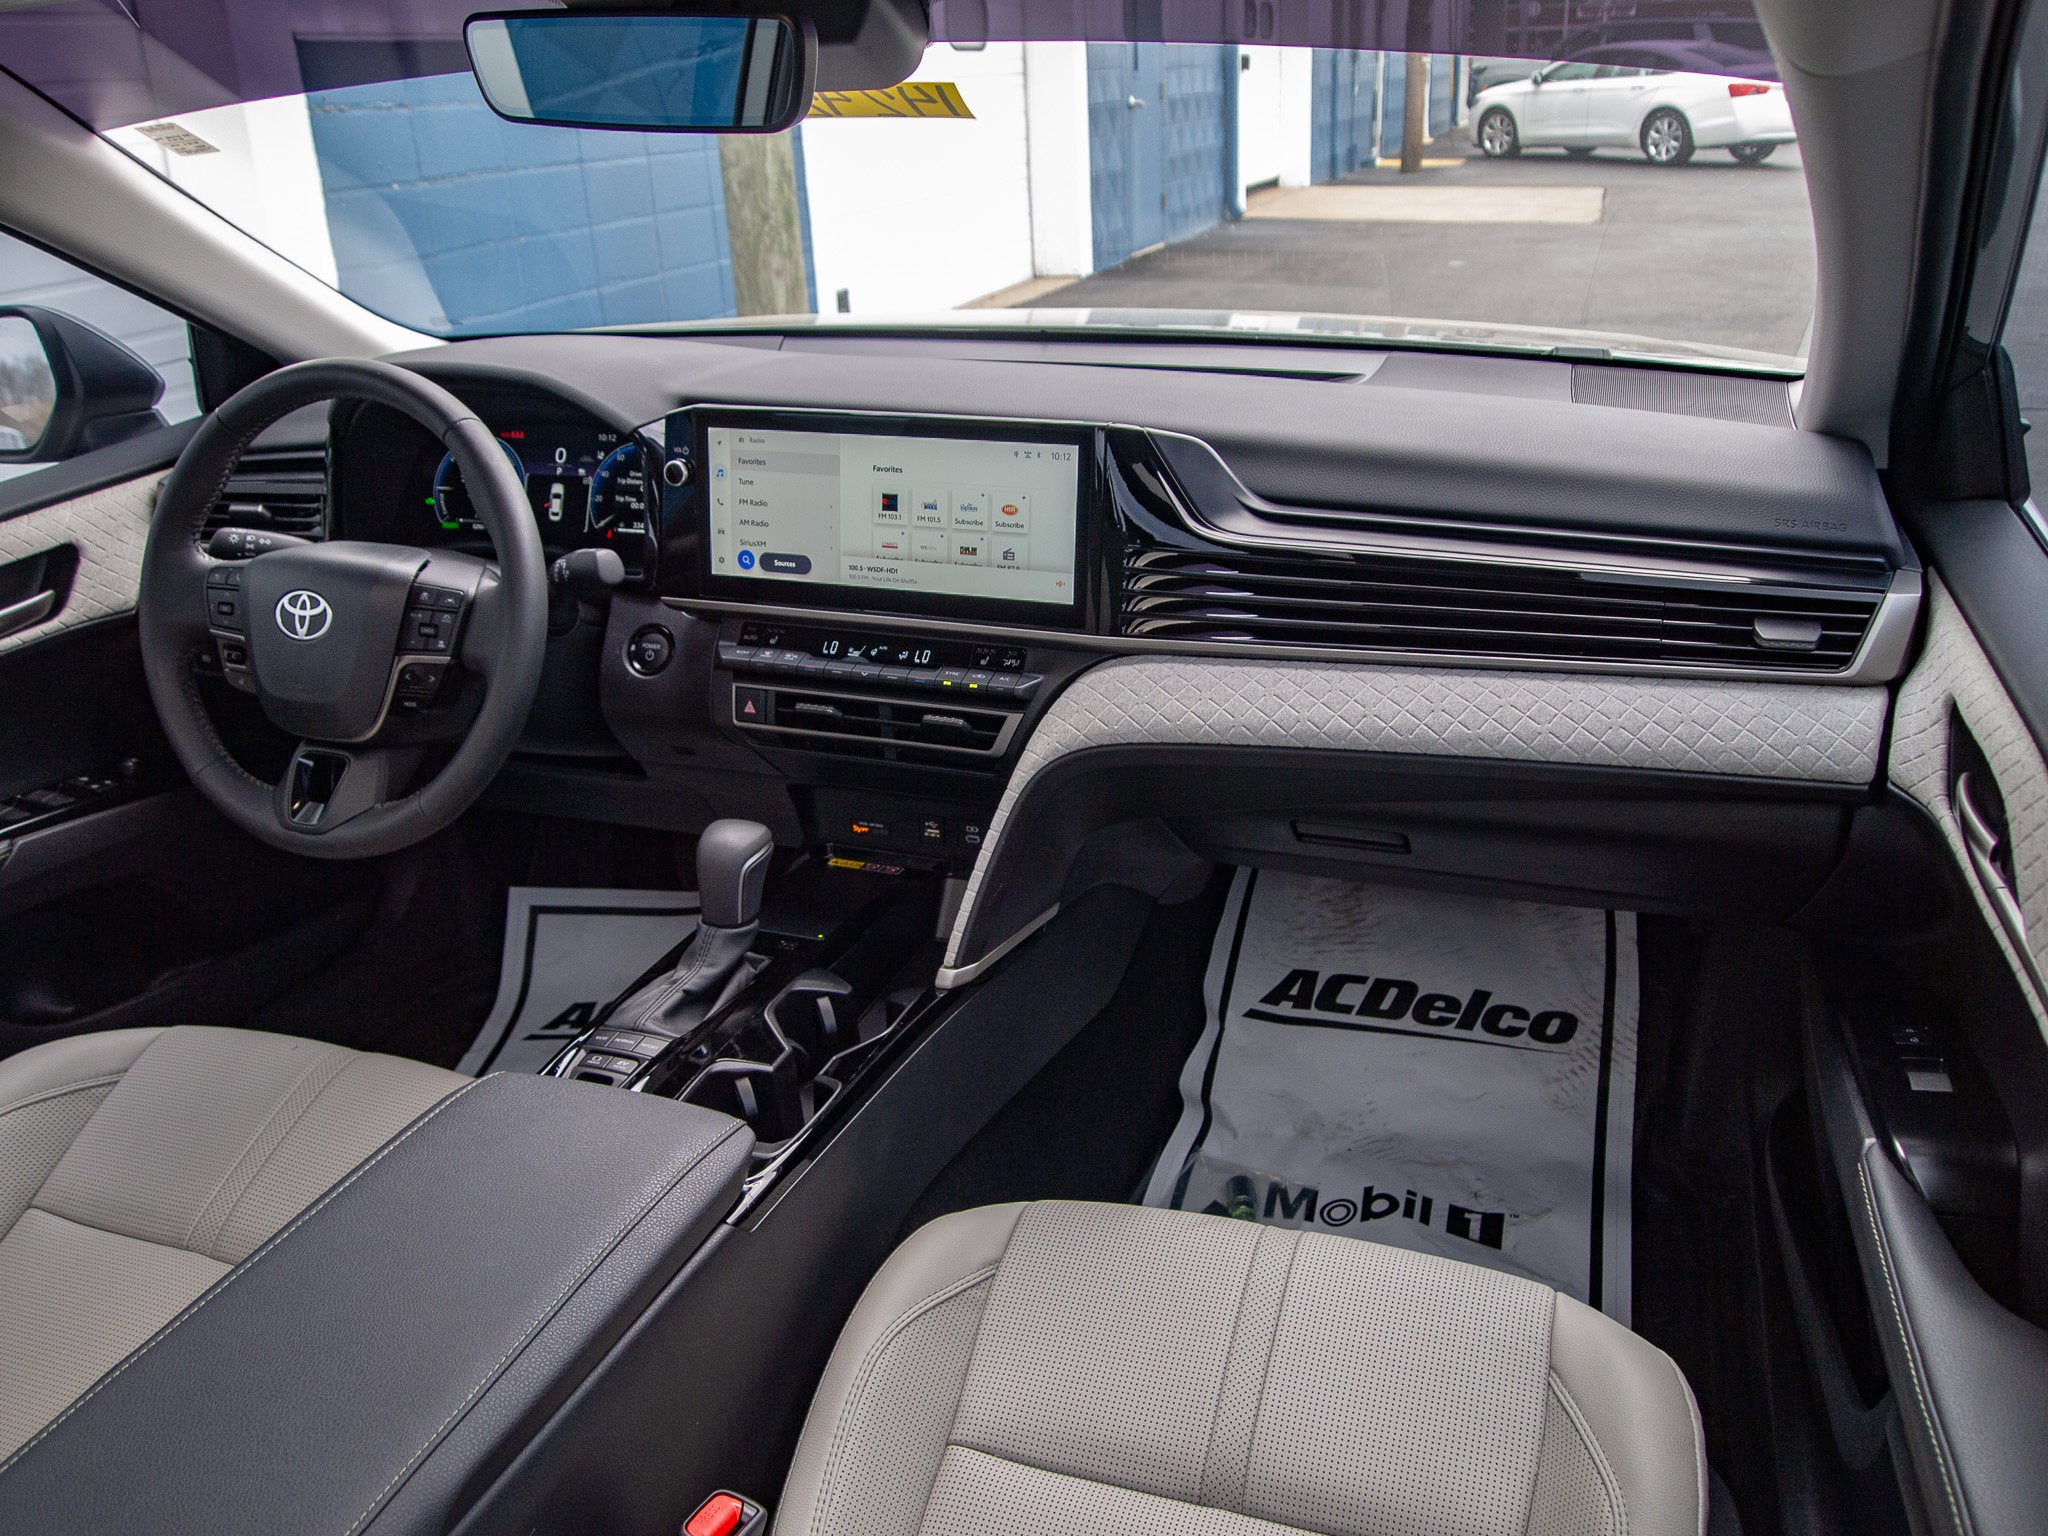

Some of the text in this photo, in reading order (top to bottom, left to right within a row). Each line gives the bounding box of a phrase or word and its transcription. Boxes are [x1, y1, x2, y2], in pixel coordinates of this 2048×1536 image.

[555, 447, 567, 463] 0
[1051, 452, 1072, 461] 10:12
[738, 457, 767, 466] Favorites
[872, 464, 903, 474] Favorites
[739, 478, 754, 486] Tune
[749, 499, 769, 507] Radio
[888, 513, 902, 521] 103.1
[750, 519, 770, 528] Radio
[954, 518, 984, 527] Subscribe
[995, 521, 1025, 529] Subscribe
[739, 539, 767, 548] SiriusXM
[774, 559, 796, 568] Sources
[848, 564, 864, 572] 100.5
[1257, 968, 1579, 1046] ACDelco
[1263, 1181, 1434, 1227] Mobil
